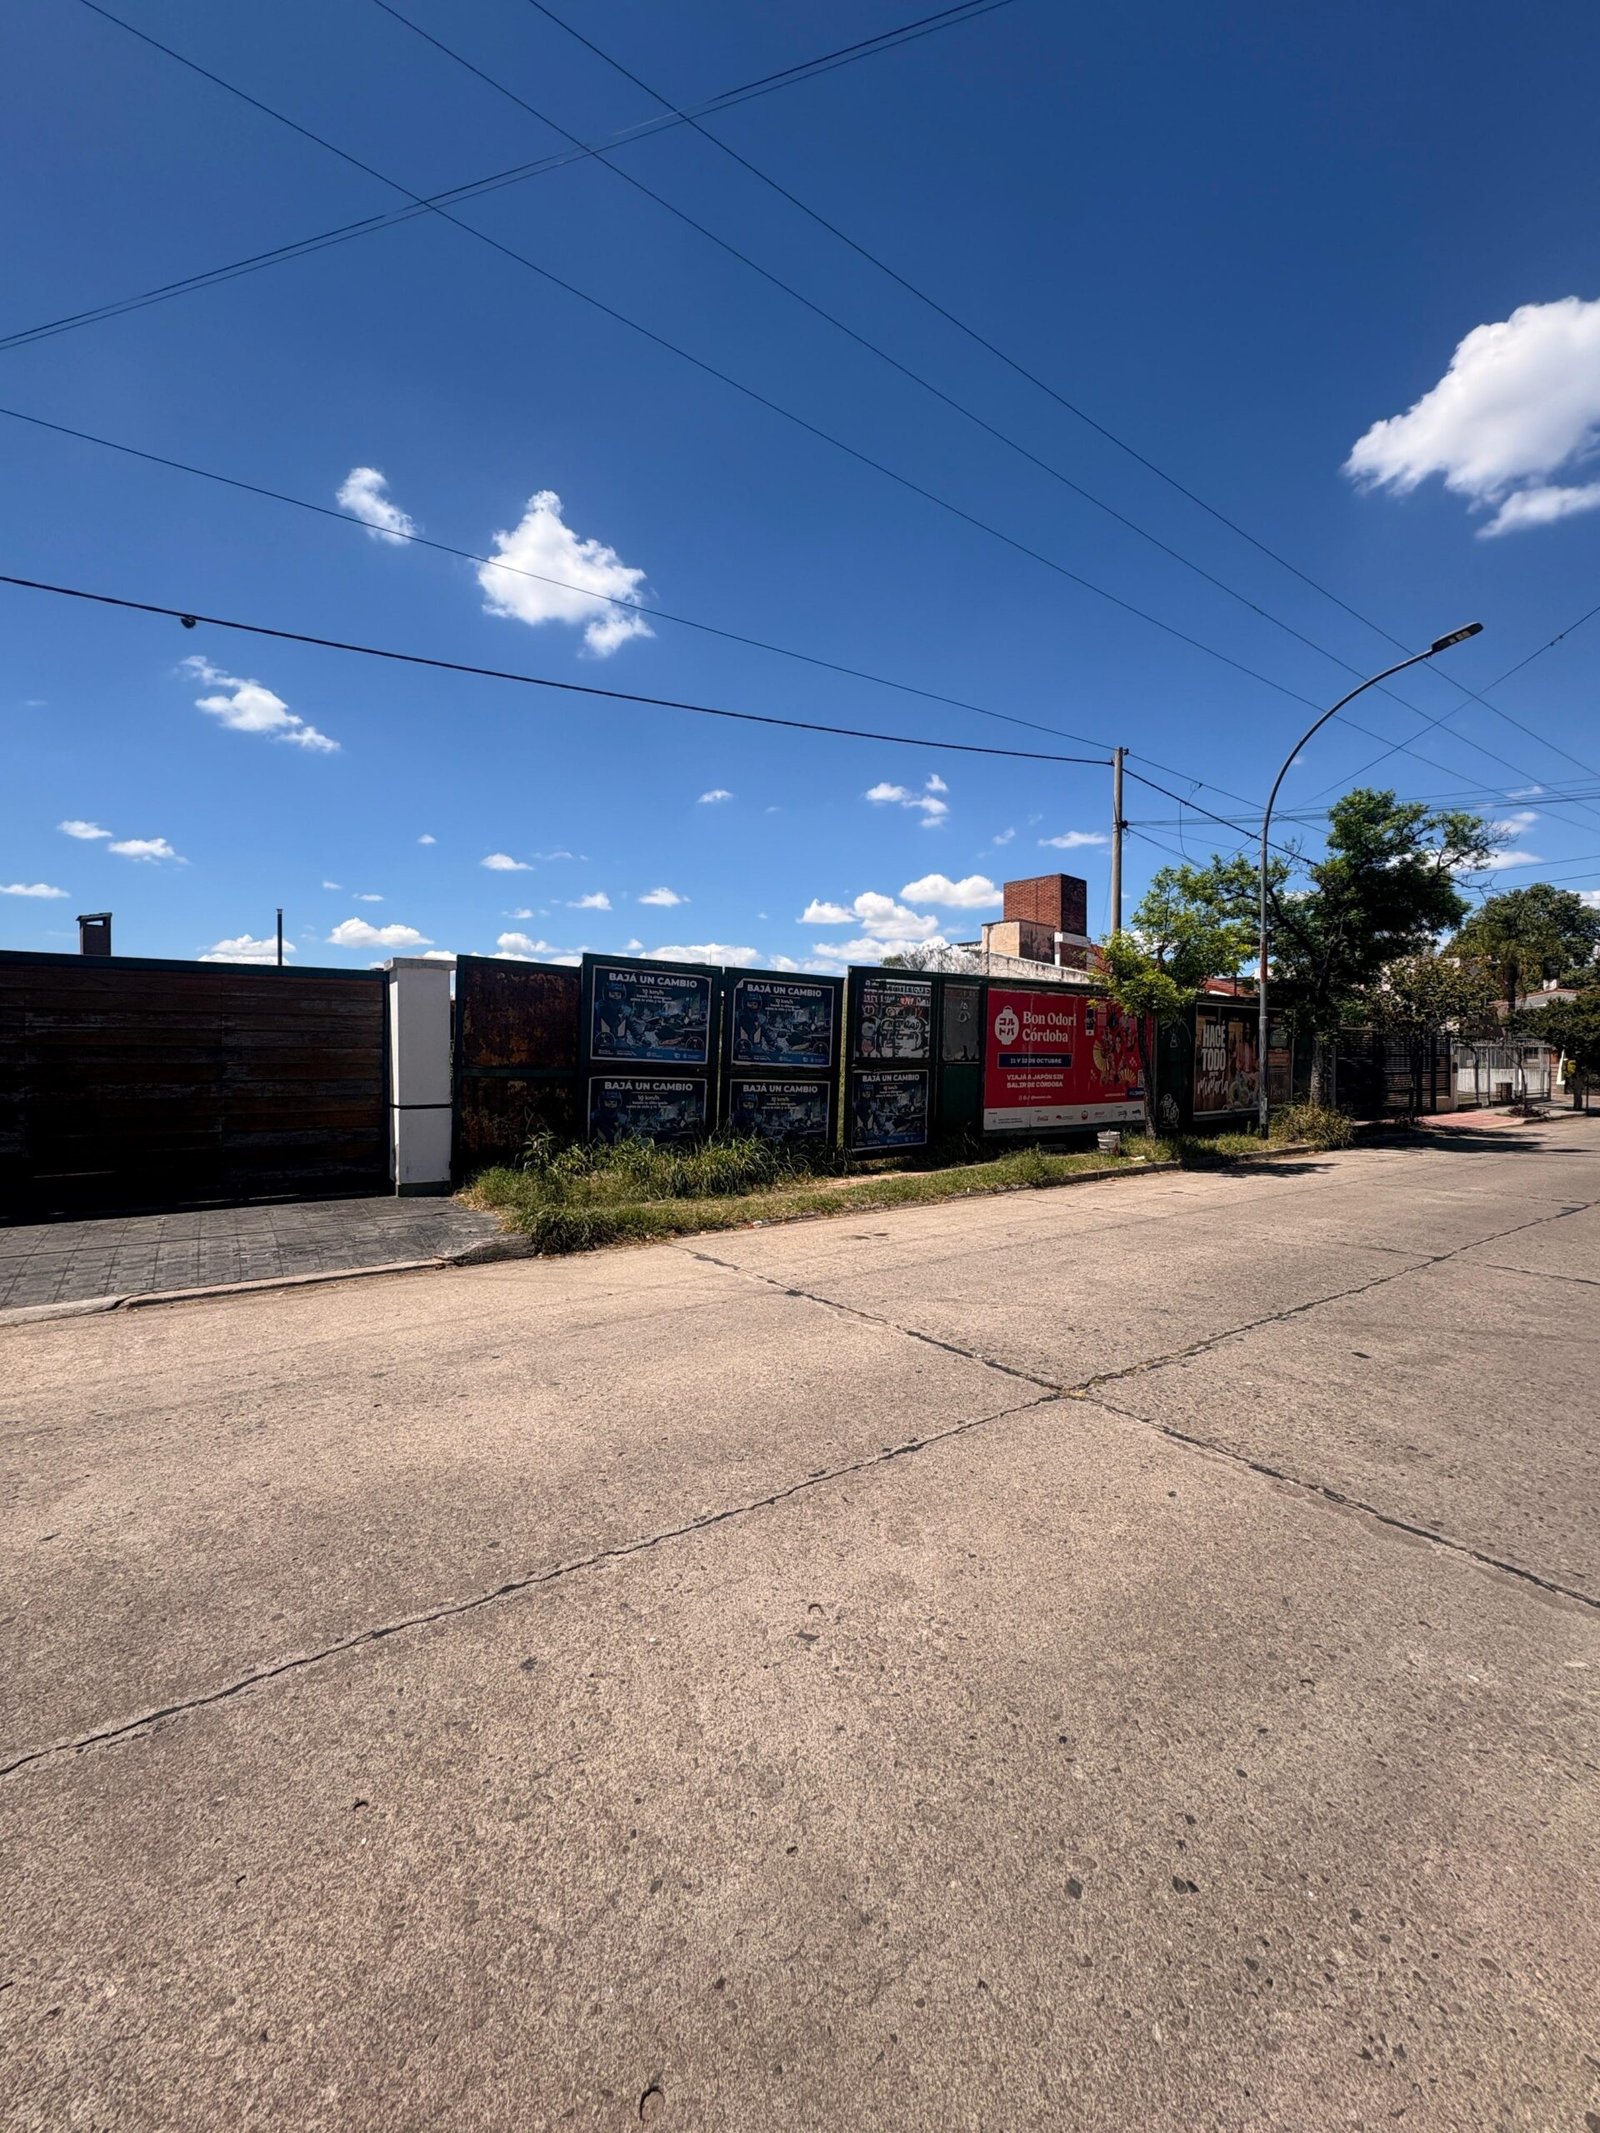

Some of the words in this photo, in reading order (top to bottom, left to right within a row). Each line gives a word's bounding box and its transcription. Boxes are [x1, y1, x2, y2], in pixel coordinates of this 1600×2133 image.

[608, 972, 637, 983] BAJÁ
[639, 976, 655, 985] UN
[657, 977, 698, 988] CAMBIO
[747, 984, 772, 993] BAJÁ
[773, 986, 786, 995] UN
[788, 987, 823, 997] CAMBIO
[1022, 1011, 1045, 1025] Bon
[1047, 1012, 1077, 1026] Odori
[1022, 1027, 1069, 1043] Córdoba
[1203, 1020, 1226, 1048] HACÉ
[1201, 1048, 1226, 1071] TODO
[862, 1073, 881, 1082] BAJÁ
[893, 1073, 920, 1081] CAMBIO
[1006, 1073, 1027, 1081] VIAJÁ
[604, 1079, 633, 1090] BAJÁ
[635, 1082, 650, 1090] UN
[652, 1082, 694, 1092] CAMBIO
[743, 1083, 768, 1092] BAJÁ
[783, 1085, 819, 1094] CAMBIO
[1036, 1080, 1064, 1088] CÓRDOBA
